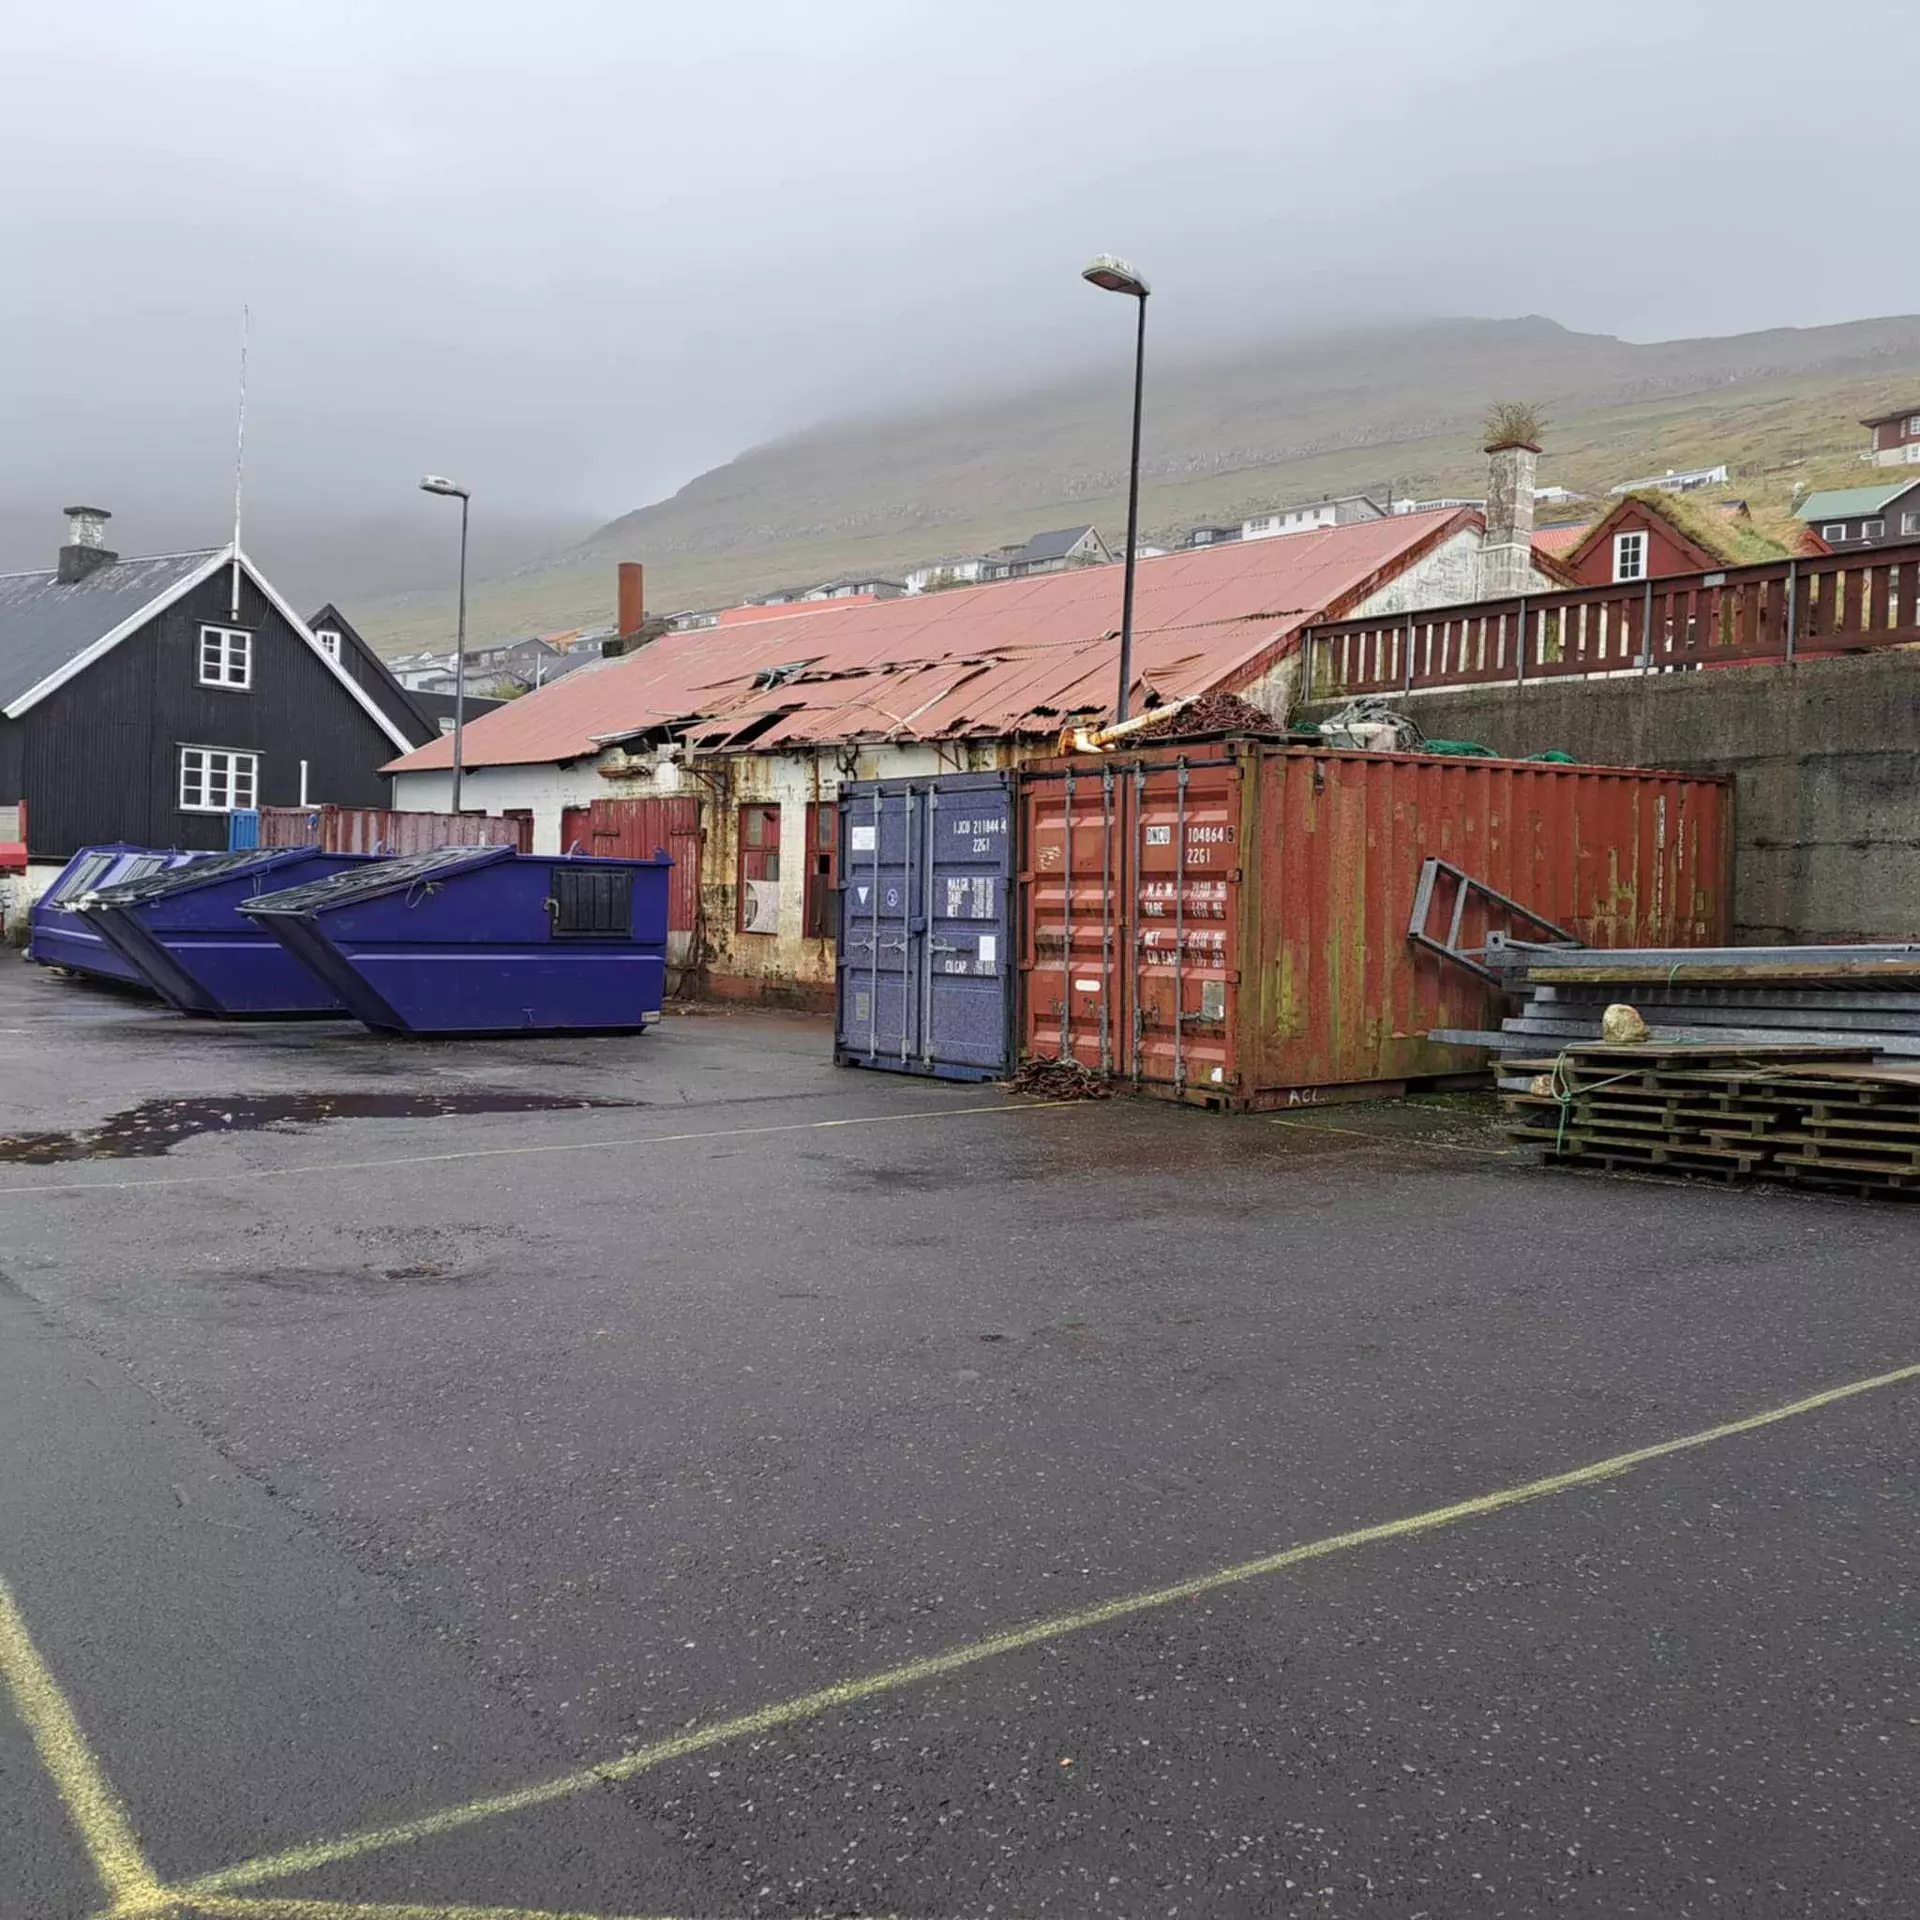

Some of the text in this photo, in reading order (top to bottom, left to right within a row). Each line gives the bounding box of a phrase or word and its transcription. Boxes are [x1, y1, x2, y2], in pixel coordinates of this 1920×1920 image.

[1188, 827, 1224, 843] 104864
[1187, 847, 1210, 863] 22G1
[1144, 901, 1165, 916] TARE
[1144, 931, 1161, 946] NET
